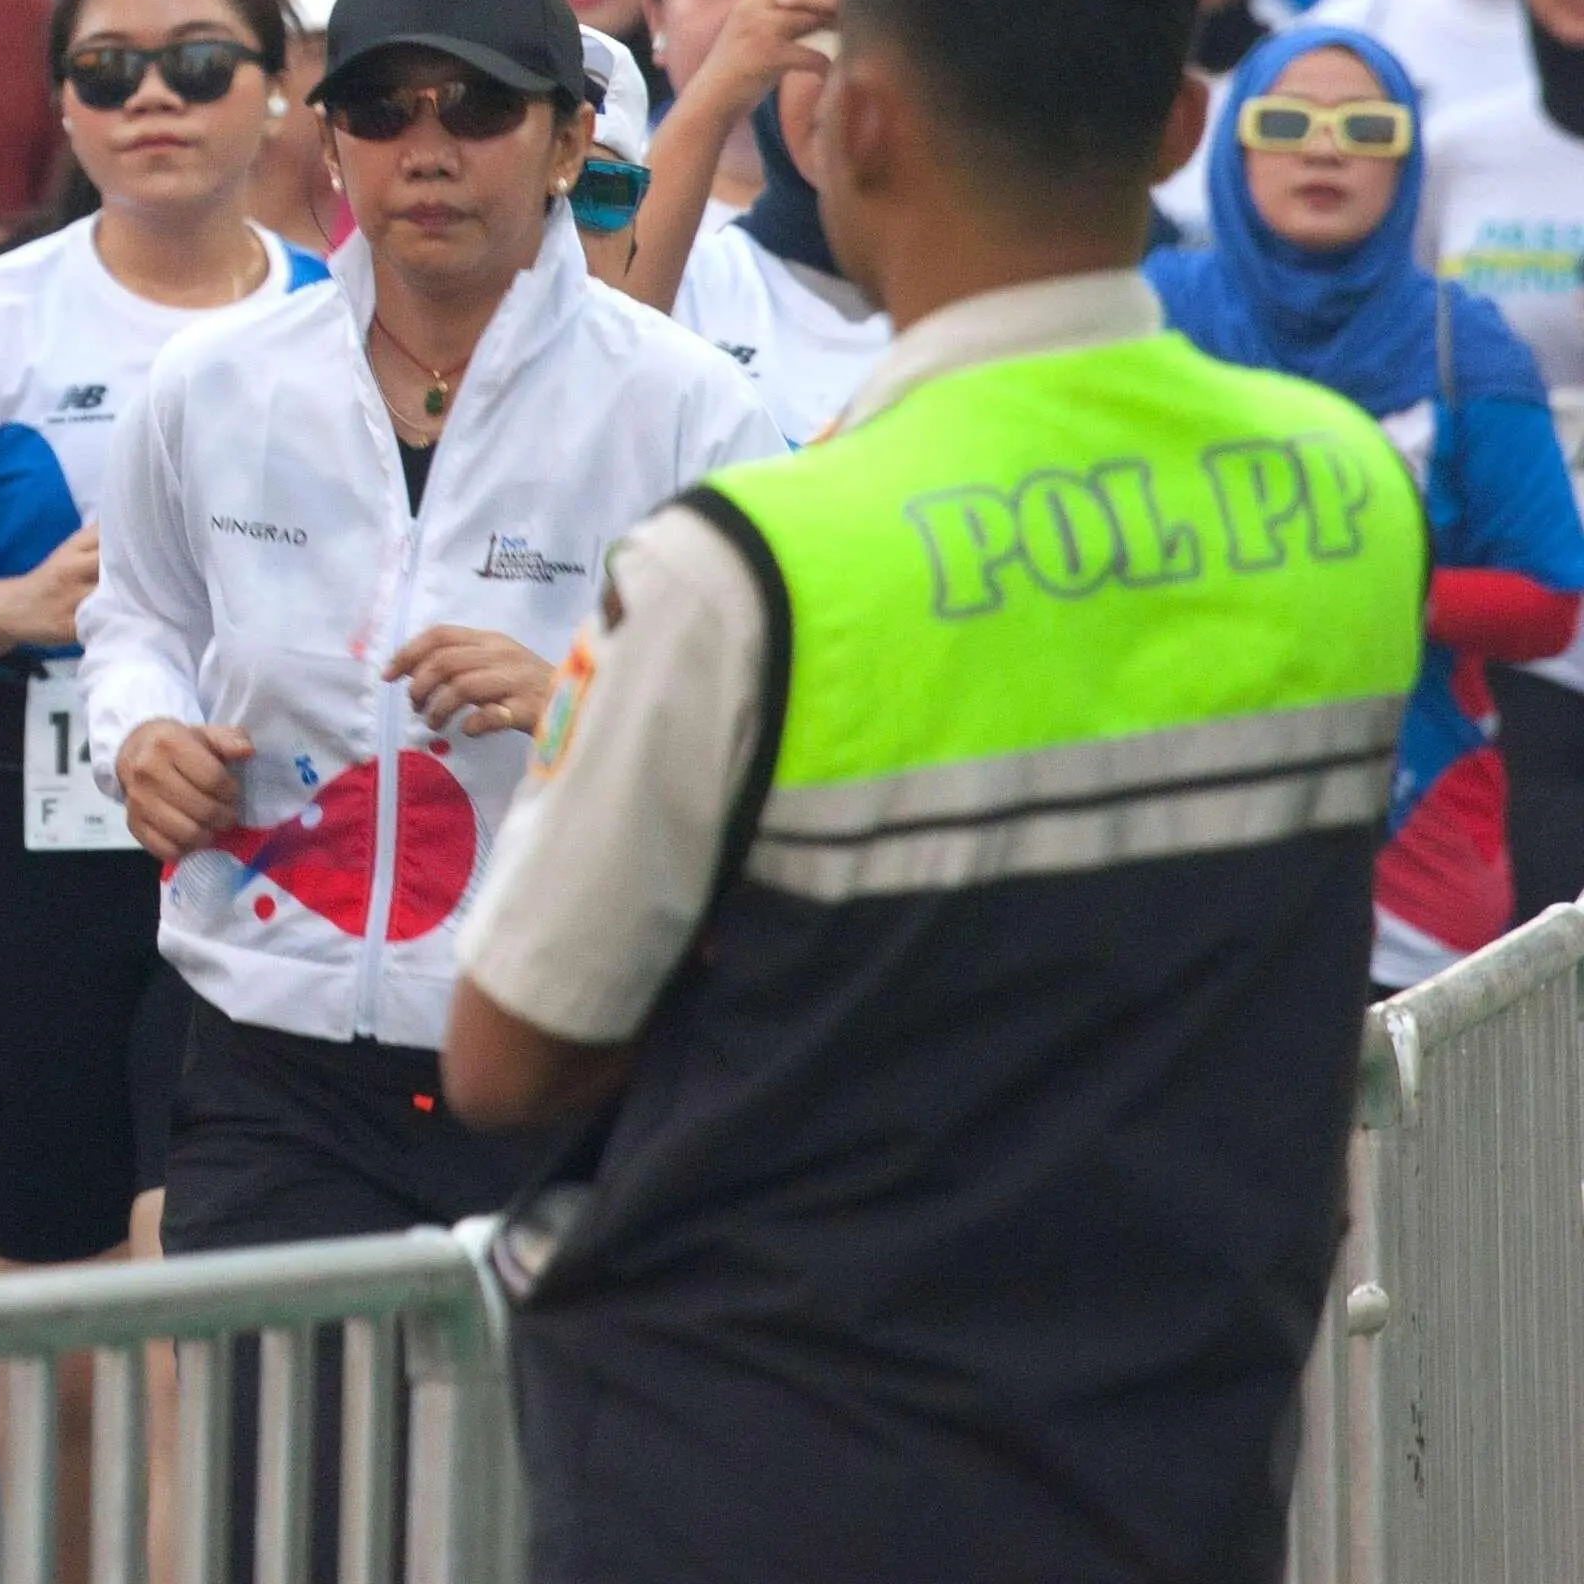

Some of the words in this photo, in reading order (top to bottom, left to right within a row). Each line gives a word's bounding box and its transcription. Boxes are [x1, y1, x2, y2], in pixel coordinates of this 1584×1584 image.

[211, 515, 308, 547] NINGRAD
[904, 455, 1203, 621] POL
[1201, 432, 1372, 573] PP
[41, 798, 58, 824] F
